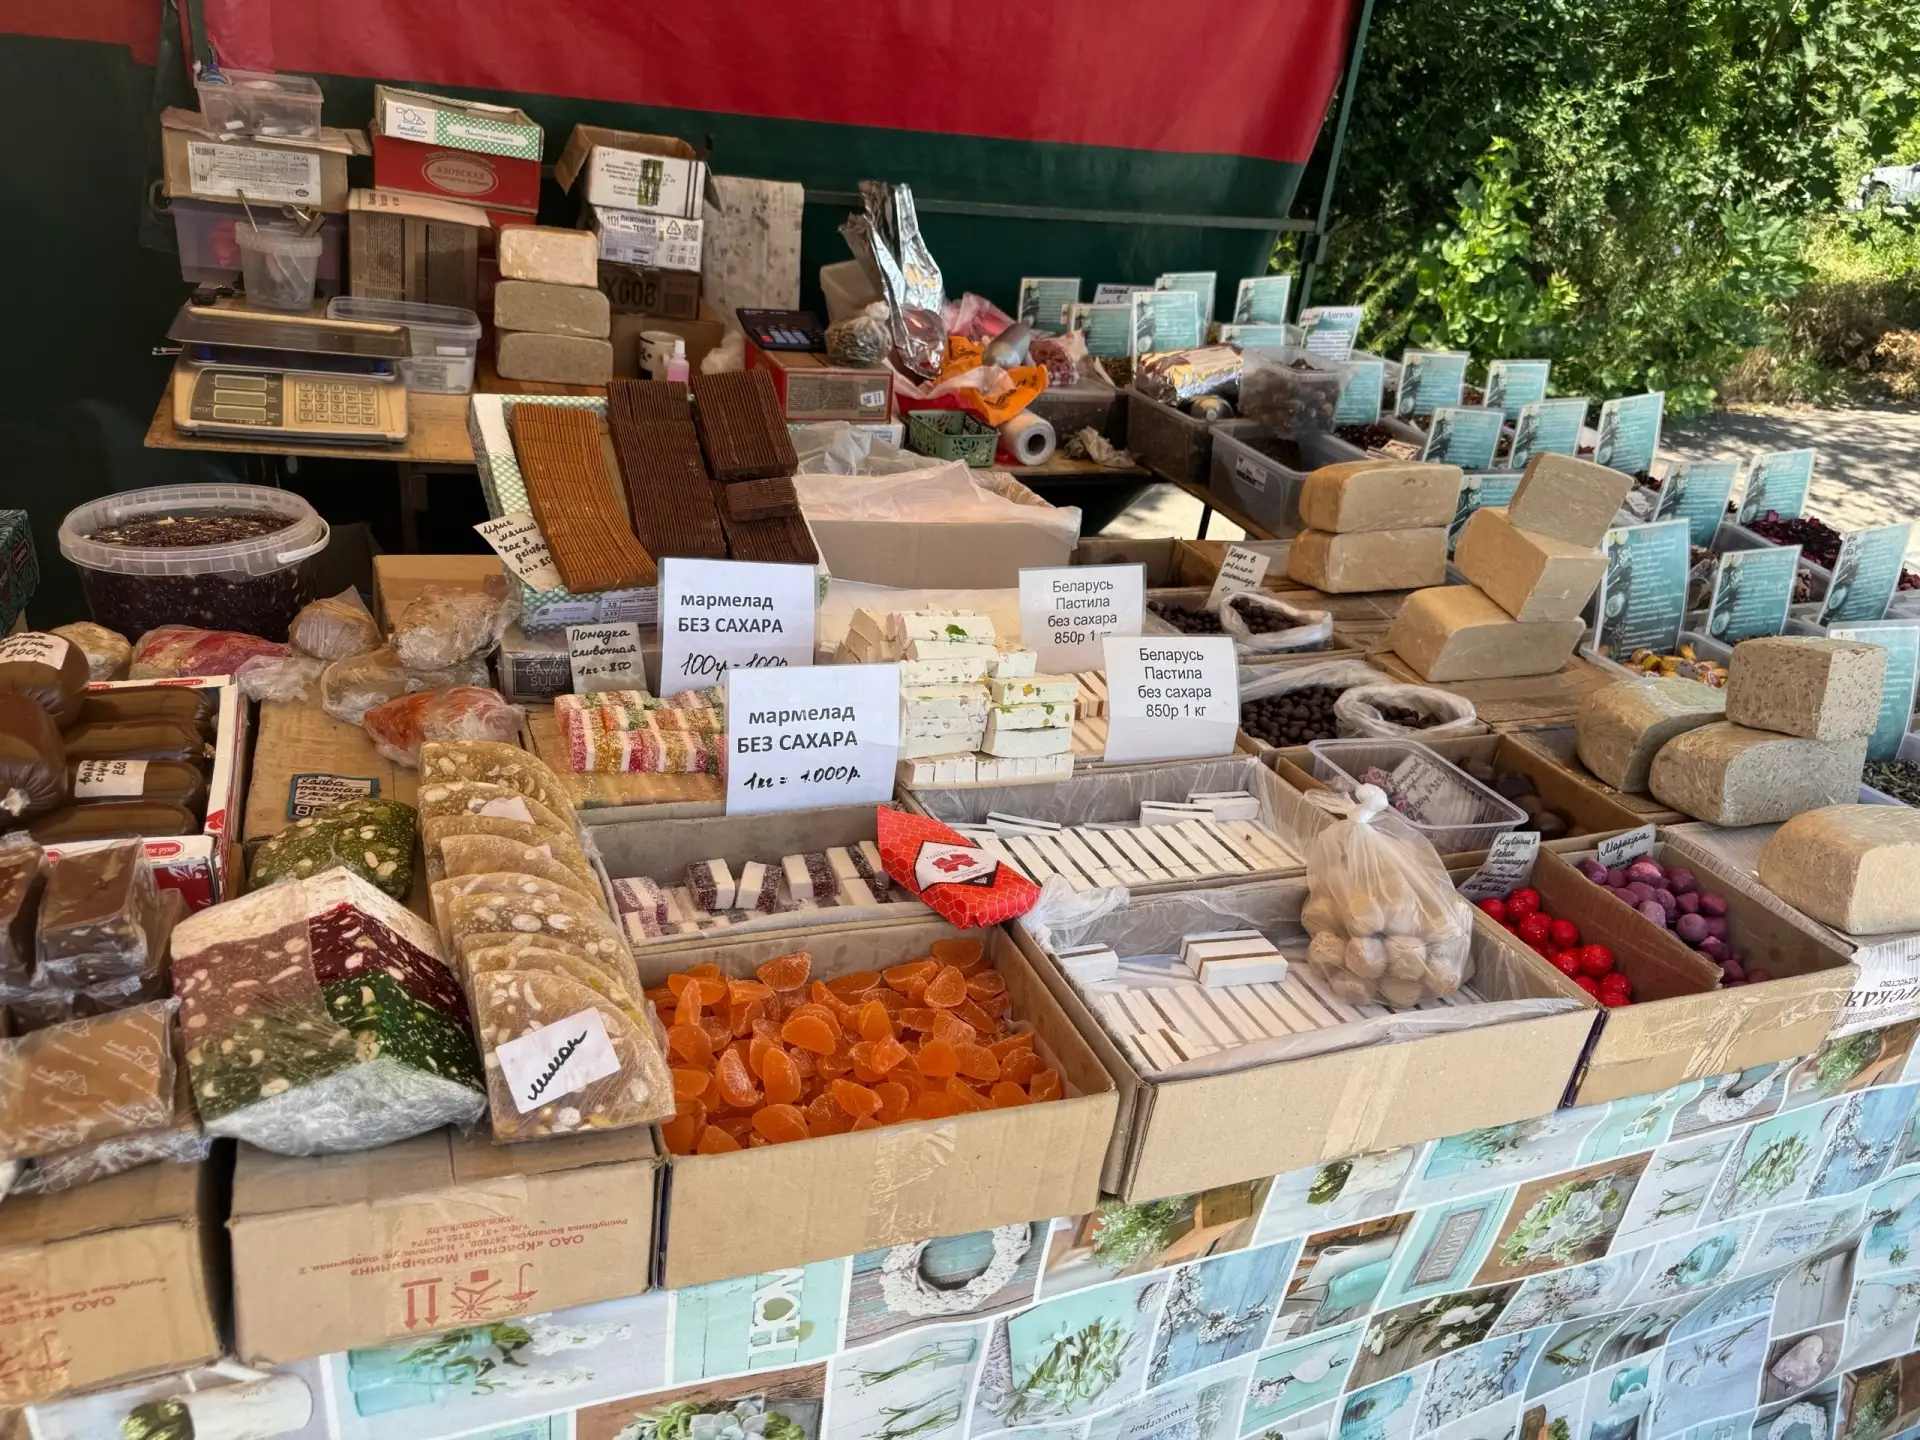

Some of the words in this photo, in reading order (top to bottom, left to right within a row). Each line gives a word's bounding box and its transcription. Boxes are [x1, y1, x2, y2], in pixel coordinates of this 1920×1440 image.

[1052, 580, 1113, 594] Беларусь
[680, 594, 774, 611] мармелад
[1056, 597, 1110, 610] Пастила
[678, 617, 710, 632] БЕЗ
[715, 617, 783, 633] САХАРА
[1048, 615, 1070, 627] без
[1074, 614, 1117, 627] сахара
[572, 629, 631, 645] Помадка
[1054, 631, 1085, 645] 850р
[1089, 630, 1096, 641] 1
[572, 644, 637, 658] сливочная
[1139, 647, 1204, 663] Беларусь
[526, 664, 569, 676] BAYAN
[609, 661, 631, 672] 850
[1144, 666, 1202, 680] Пастила
[531, 676, 565, 687] SULU
[1138, 685, 1161, 698] без
[1165, 687, 1212, 700] сахара
[748, 706, 856, 726] мармелад
[1146, 704, 1179, 720] 850р
[1183, 704, 1189, 716] 1
[1195, 706, 1206, 716] кг
[737, 736, 773, 753] БЕЗ
[779, 730, 858, 751] САХАРА
[744, 772, 774, 790] 1кг
[568, 1218, 628, 1232] Республика
[549, 1235, 584, 1247] ОАО
[463, 1240, 544, 1260] «Красный
[72, 1296, 116, 1312] ОАО
